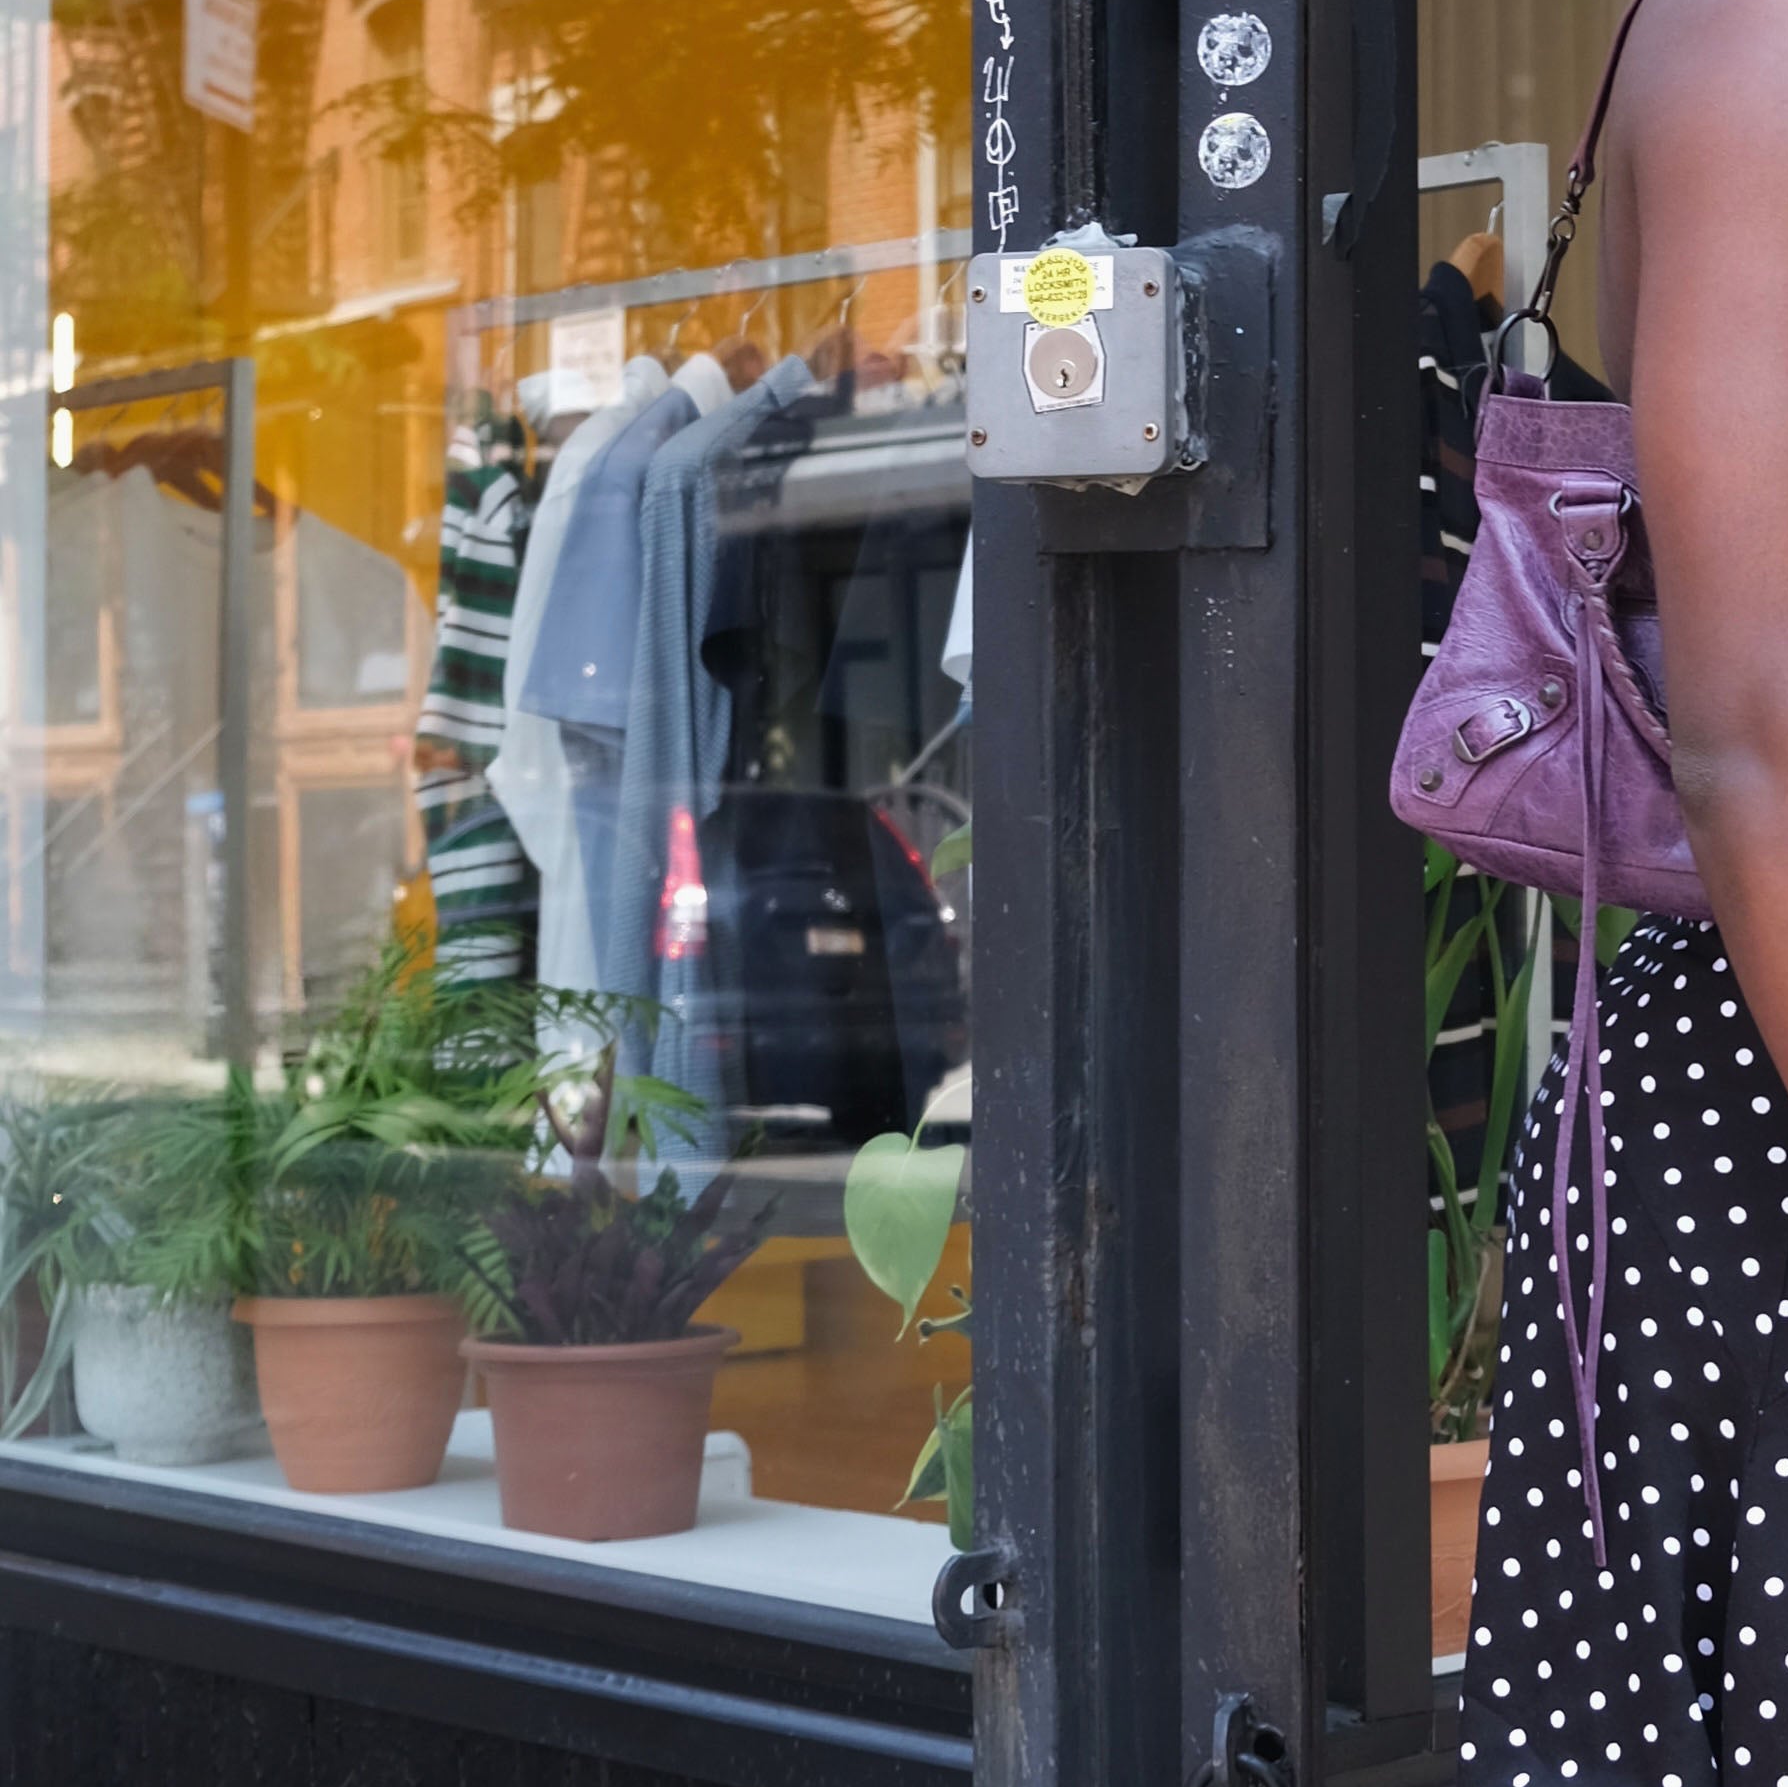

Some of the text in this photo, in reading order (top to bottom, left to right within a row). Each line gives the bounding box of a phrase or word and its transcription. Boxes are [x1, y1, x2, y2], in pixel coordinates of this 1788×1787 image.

[1042, 267, 1071, 280] 24 HR
[1027, 278, 1088, 292] LOCKSMITH
[1032, 302, 1088, 323] EMERGENCY
